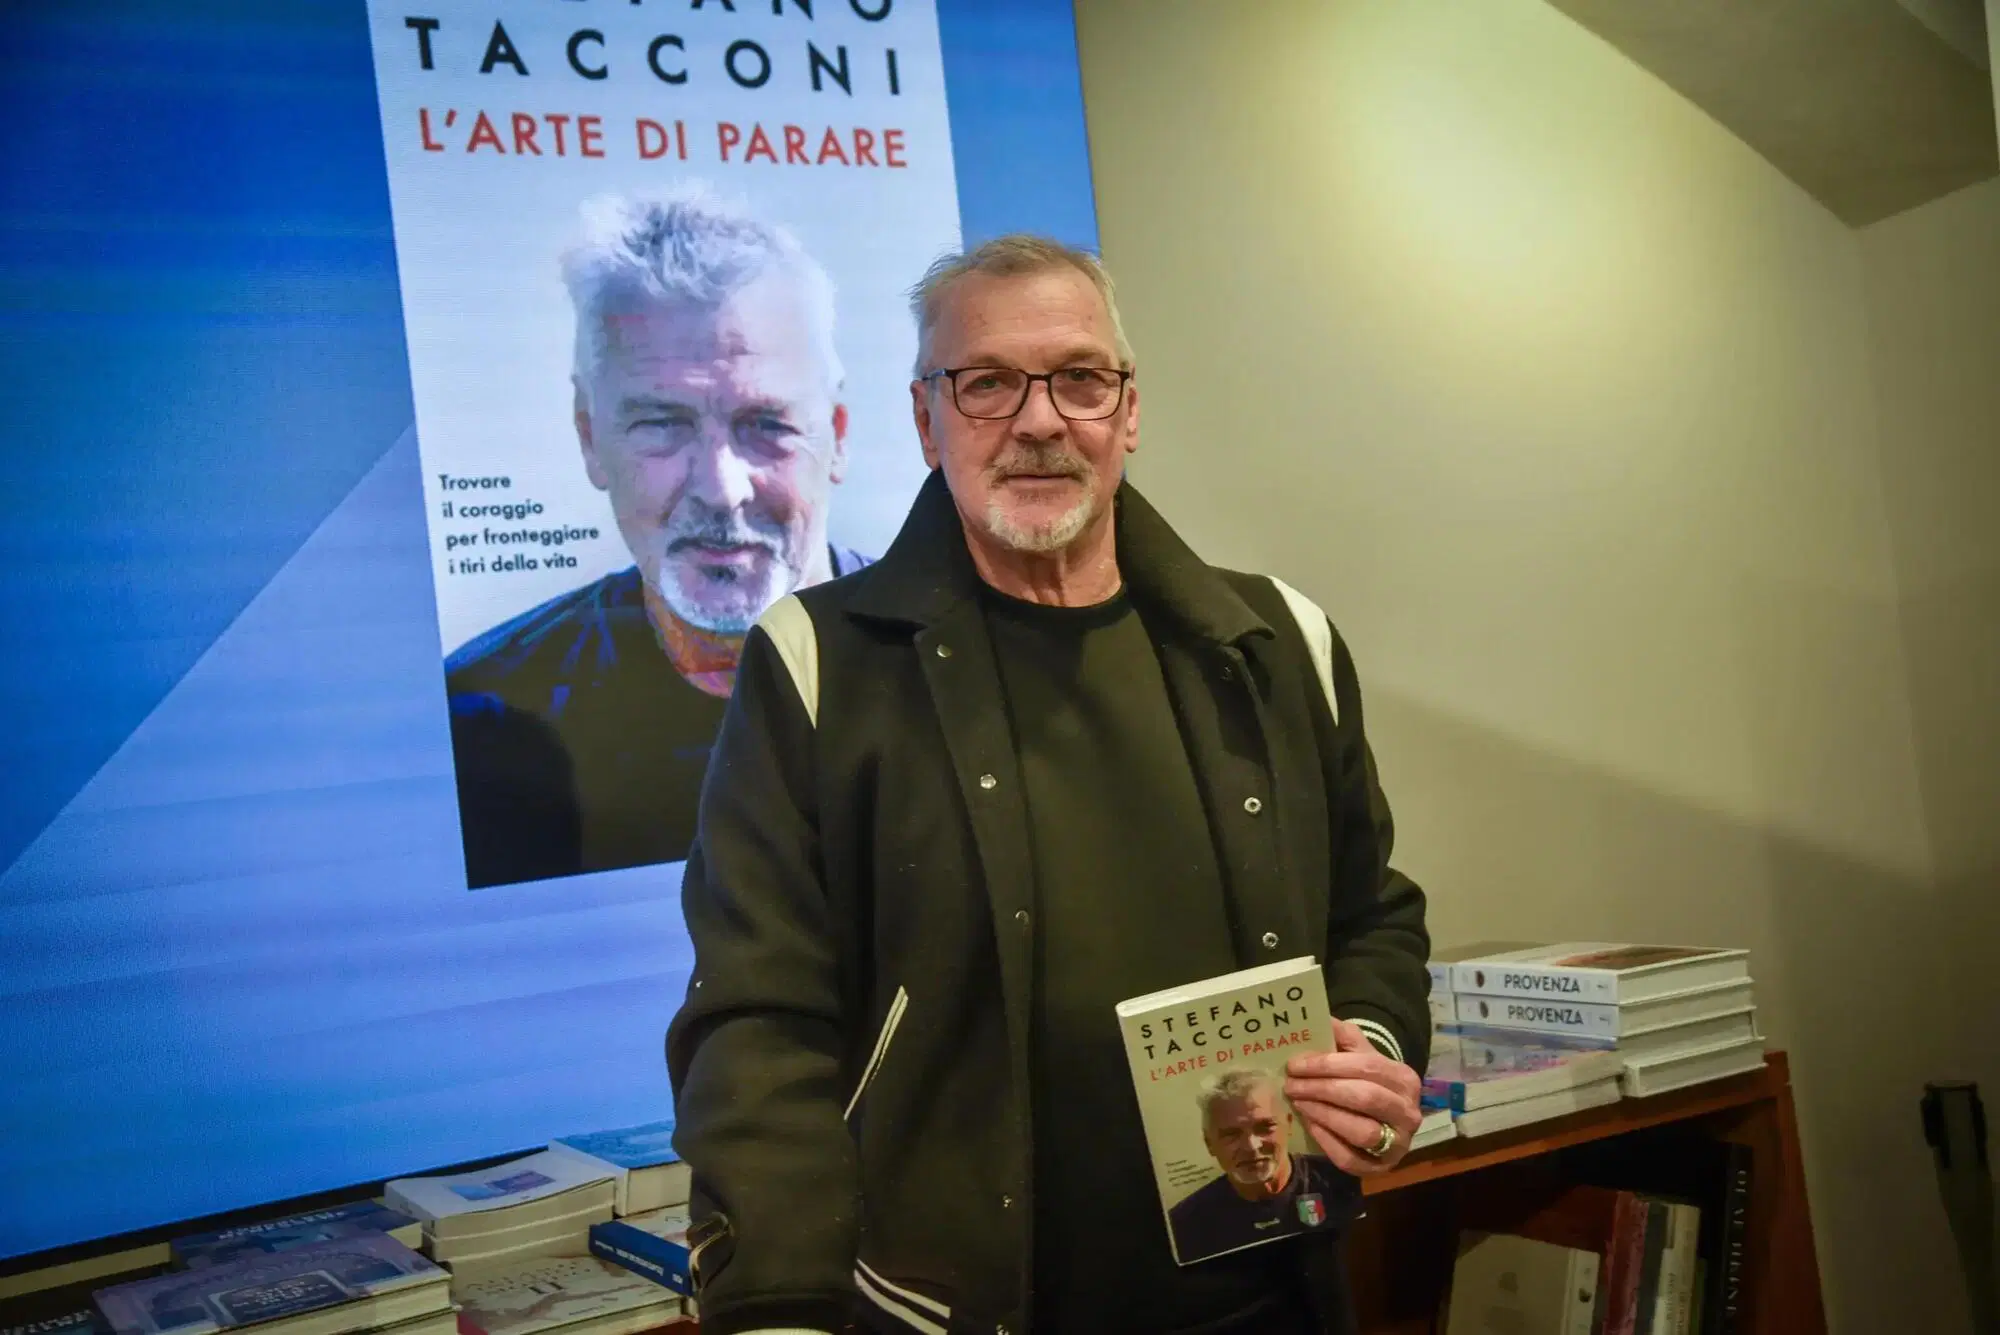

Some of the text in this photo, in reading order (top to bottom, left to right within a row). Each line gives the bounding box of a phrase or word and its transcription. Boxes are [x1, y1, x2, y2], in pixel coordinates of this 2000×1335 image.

[405, 16, 900, 95] TACCONI
[636, 119, 687, 160] DI
[718, 123, 907, 168] PARARE
[438, 474, 511, 491] Trovare
[442, 499, 544, 520] il coraggio
[446, 525, 600, 552] per fronteggiare
[448, 552, 578, 575] i tiri della vita
[1503, 973, 1581, 994] PROVENZA
[1140, 986, 1304, 1039] STEFANO
[1507, 1004, 1584, 1026] PROVENZA
[1143, 1006, 1308, 1060] TACCONI
[1216, 1049, 1235, 1064] DI
[1242, 1028, 1313, 1055] PARARE
